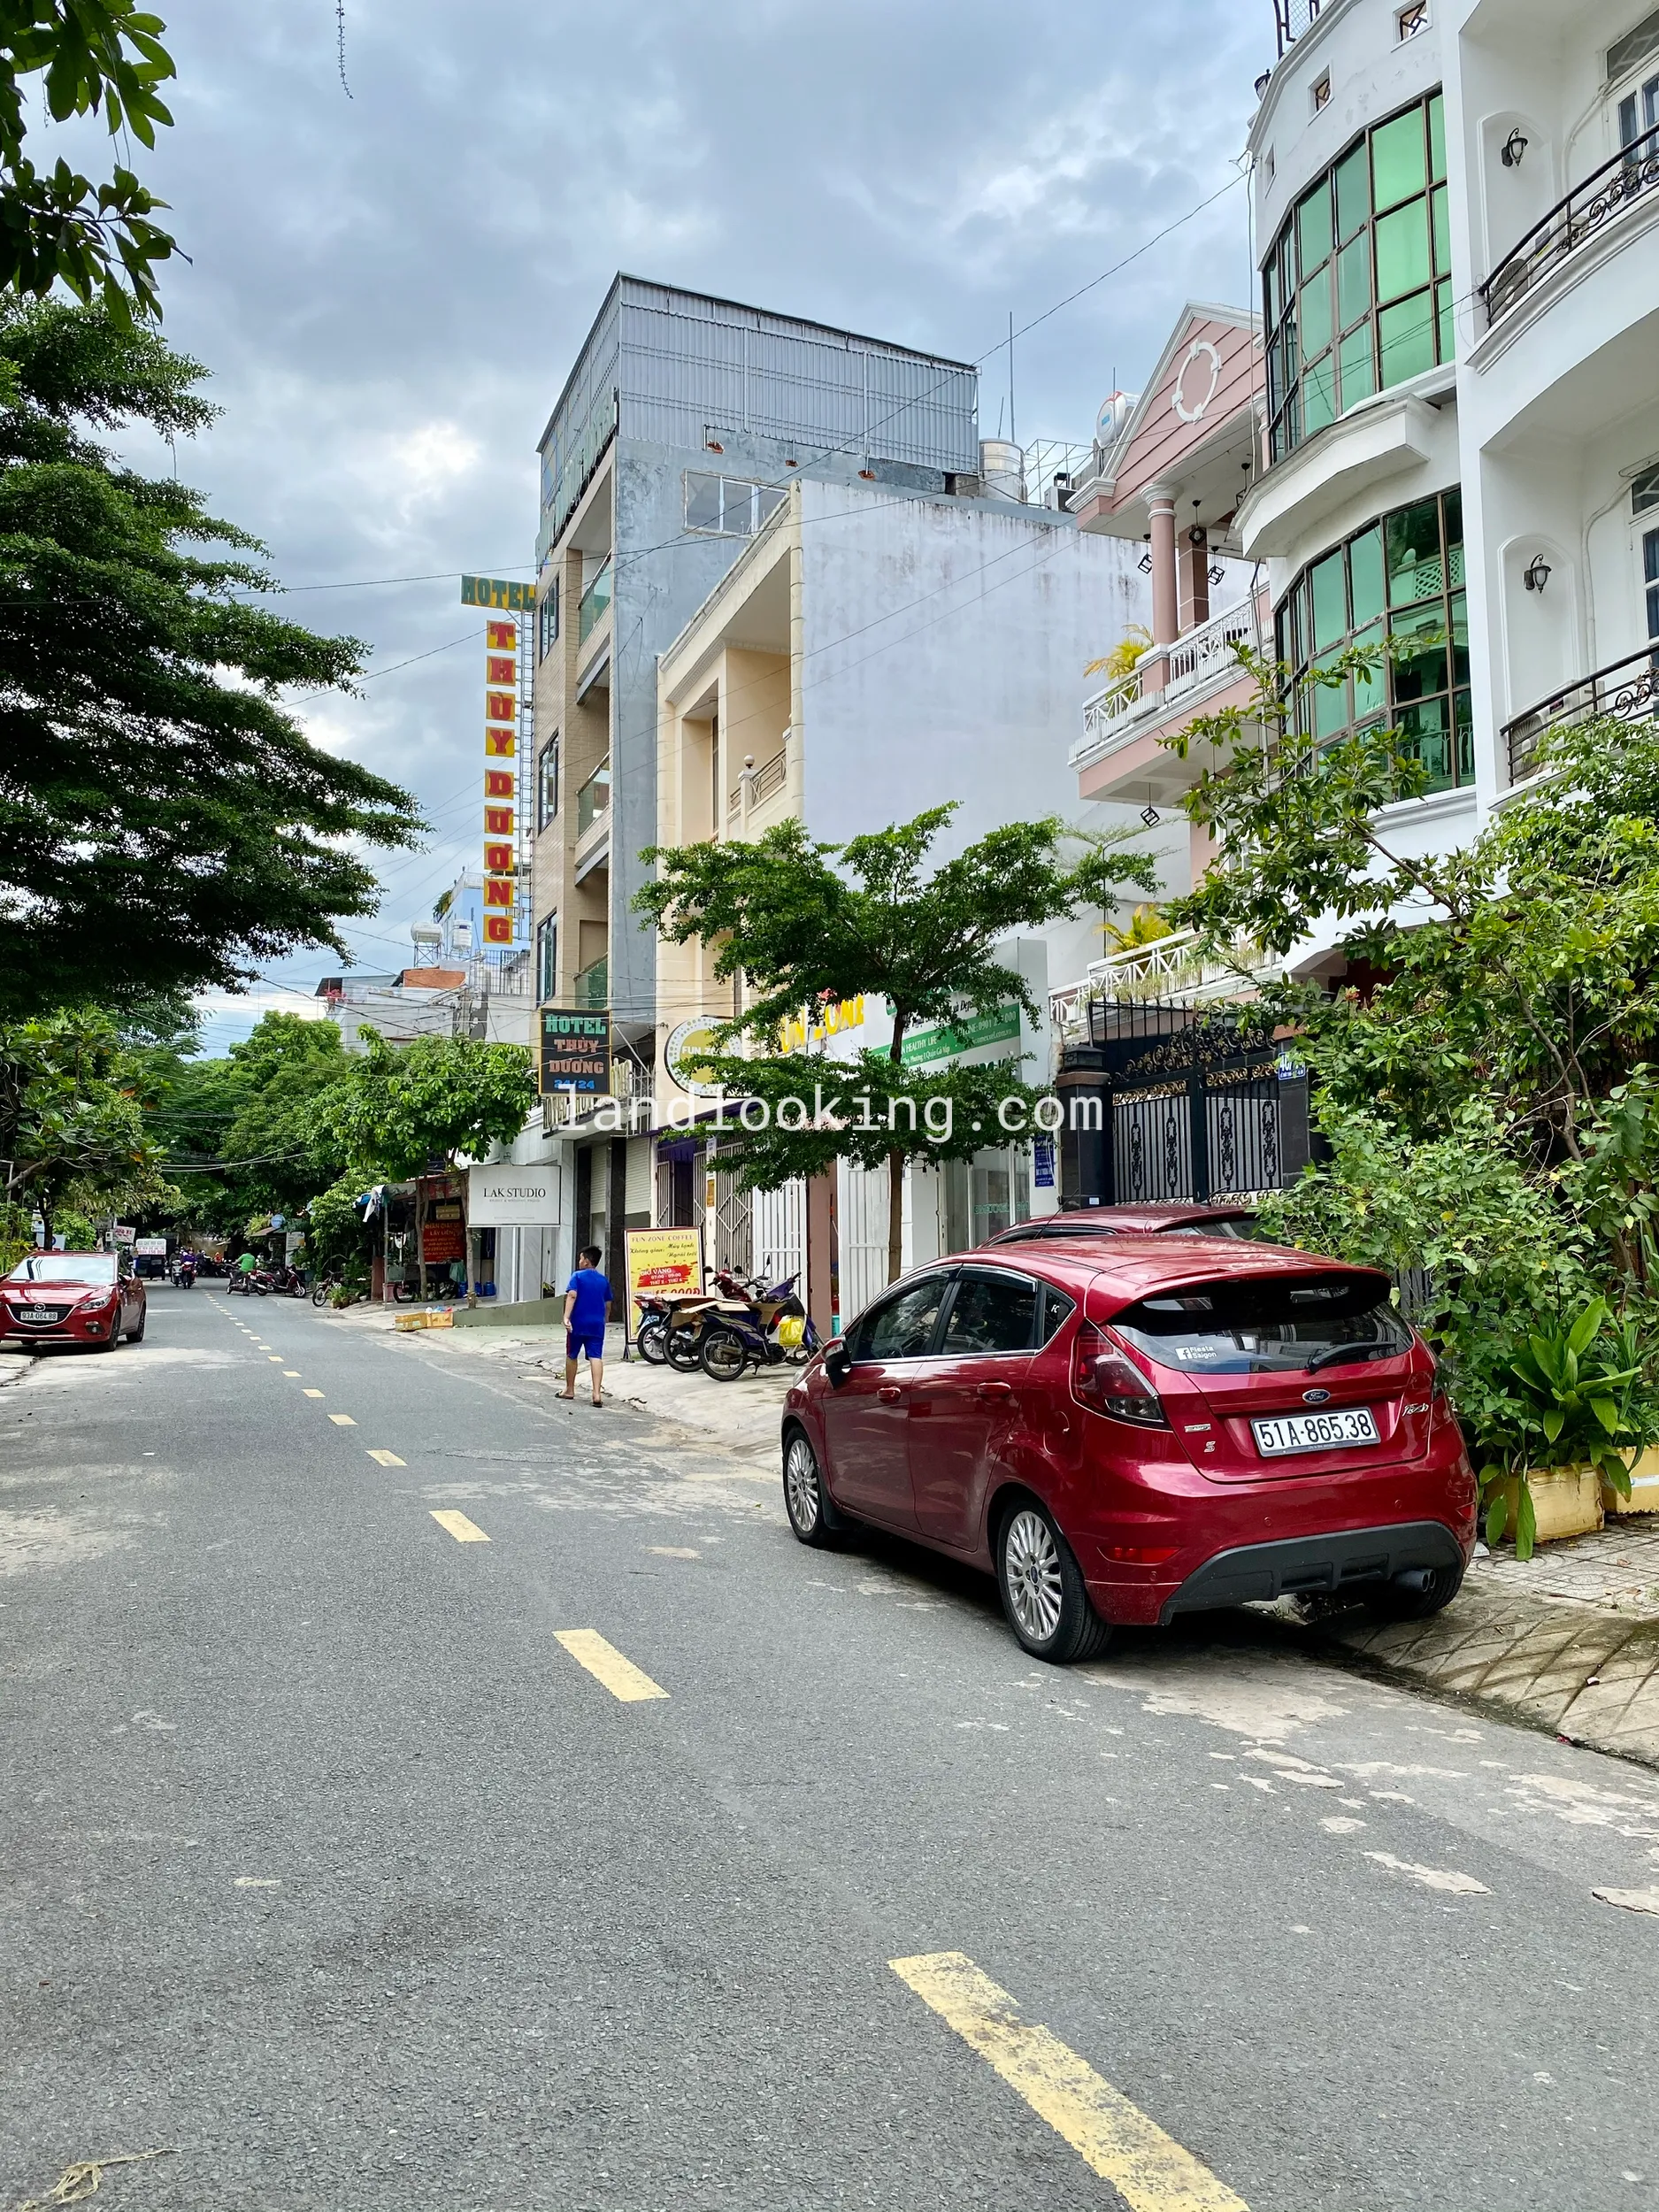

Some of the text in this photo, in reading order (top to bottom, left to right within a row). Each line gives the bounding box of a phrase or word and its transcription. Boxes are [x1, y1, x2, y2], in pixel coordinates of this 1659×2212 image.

[461, 574, 536, 611] HOTEL
[545, 1014, 606, 1035] HOTEL
[553, 1036, 599, 1053] THÙY
[681, 1045, 702, 1056] FUN
[905, 1038, 926, 1054] HEALTHY
[927, 1035, 937, 1047] LIFE
[549, 1057, 604, 1074] DƯƠNG
[483, 1187, 546, 1198] LAK STUDIO
[1203, 1440, 1216, 1453] S
